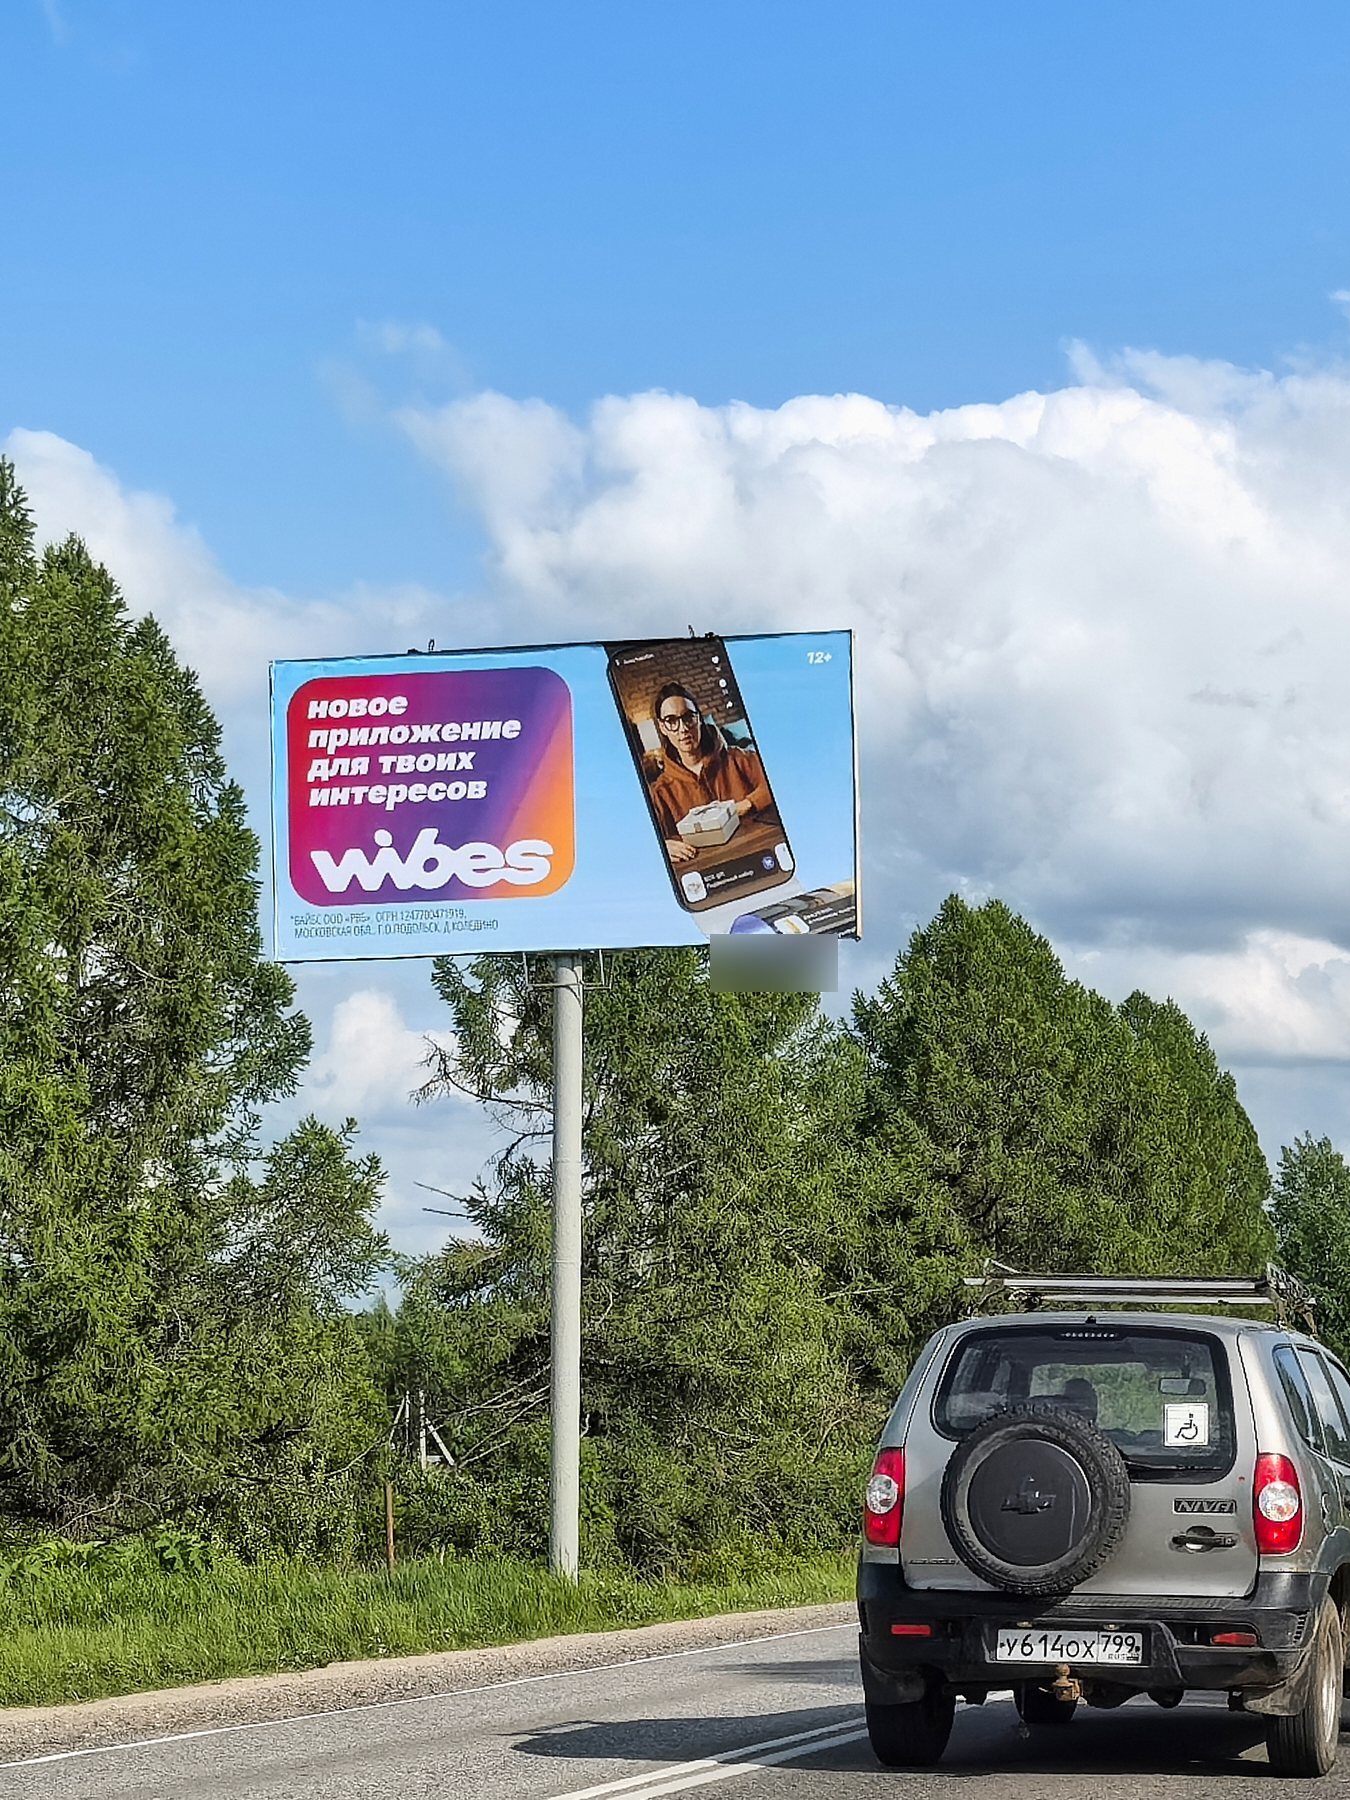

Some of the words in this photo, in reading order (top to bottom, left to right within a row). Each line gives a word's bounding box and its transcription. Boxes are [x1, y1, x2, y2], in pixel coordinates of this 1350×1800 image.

[807, 651, 832, 665] 12+
[307, 695, 408, 719] новое
[307, 719, 522, 754] приложение
[307, 756, 370, 782] для
[378, 751, 476, 774] твоих
[308, 780, 488, 811] интересов
[310, 827, 554, 893] wibes
[1178, 1501, 1232, 1512] NIVA
[1101, 1635, 1136, 1653] 799
